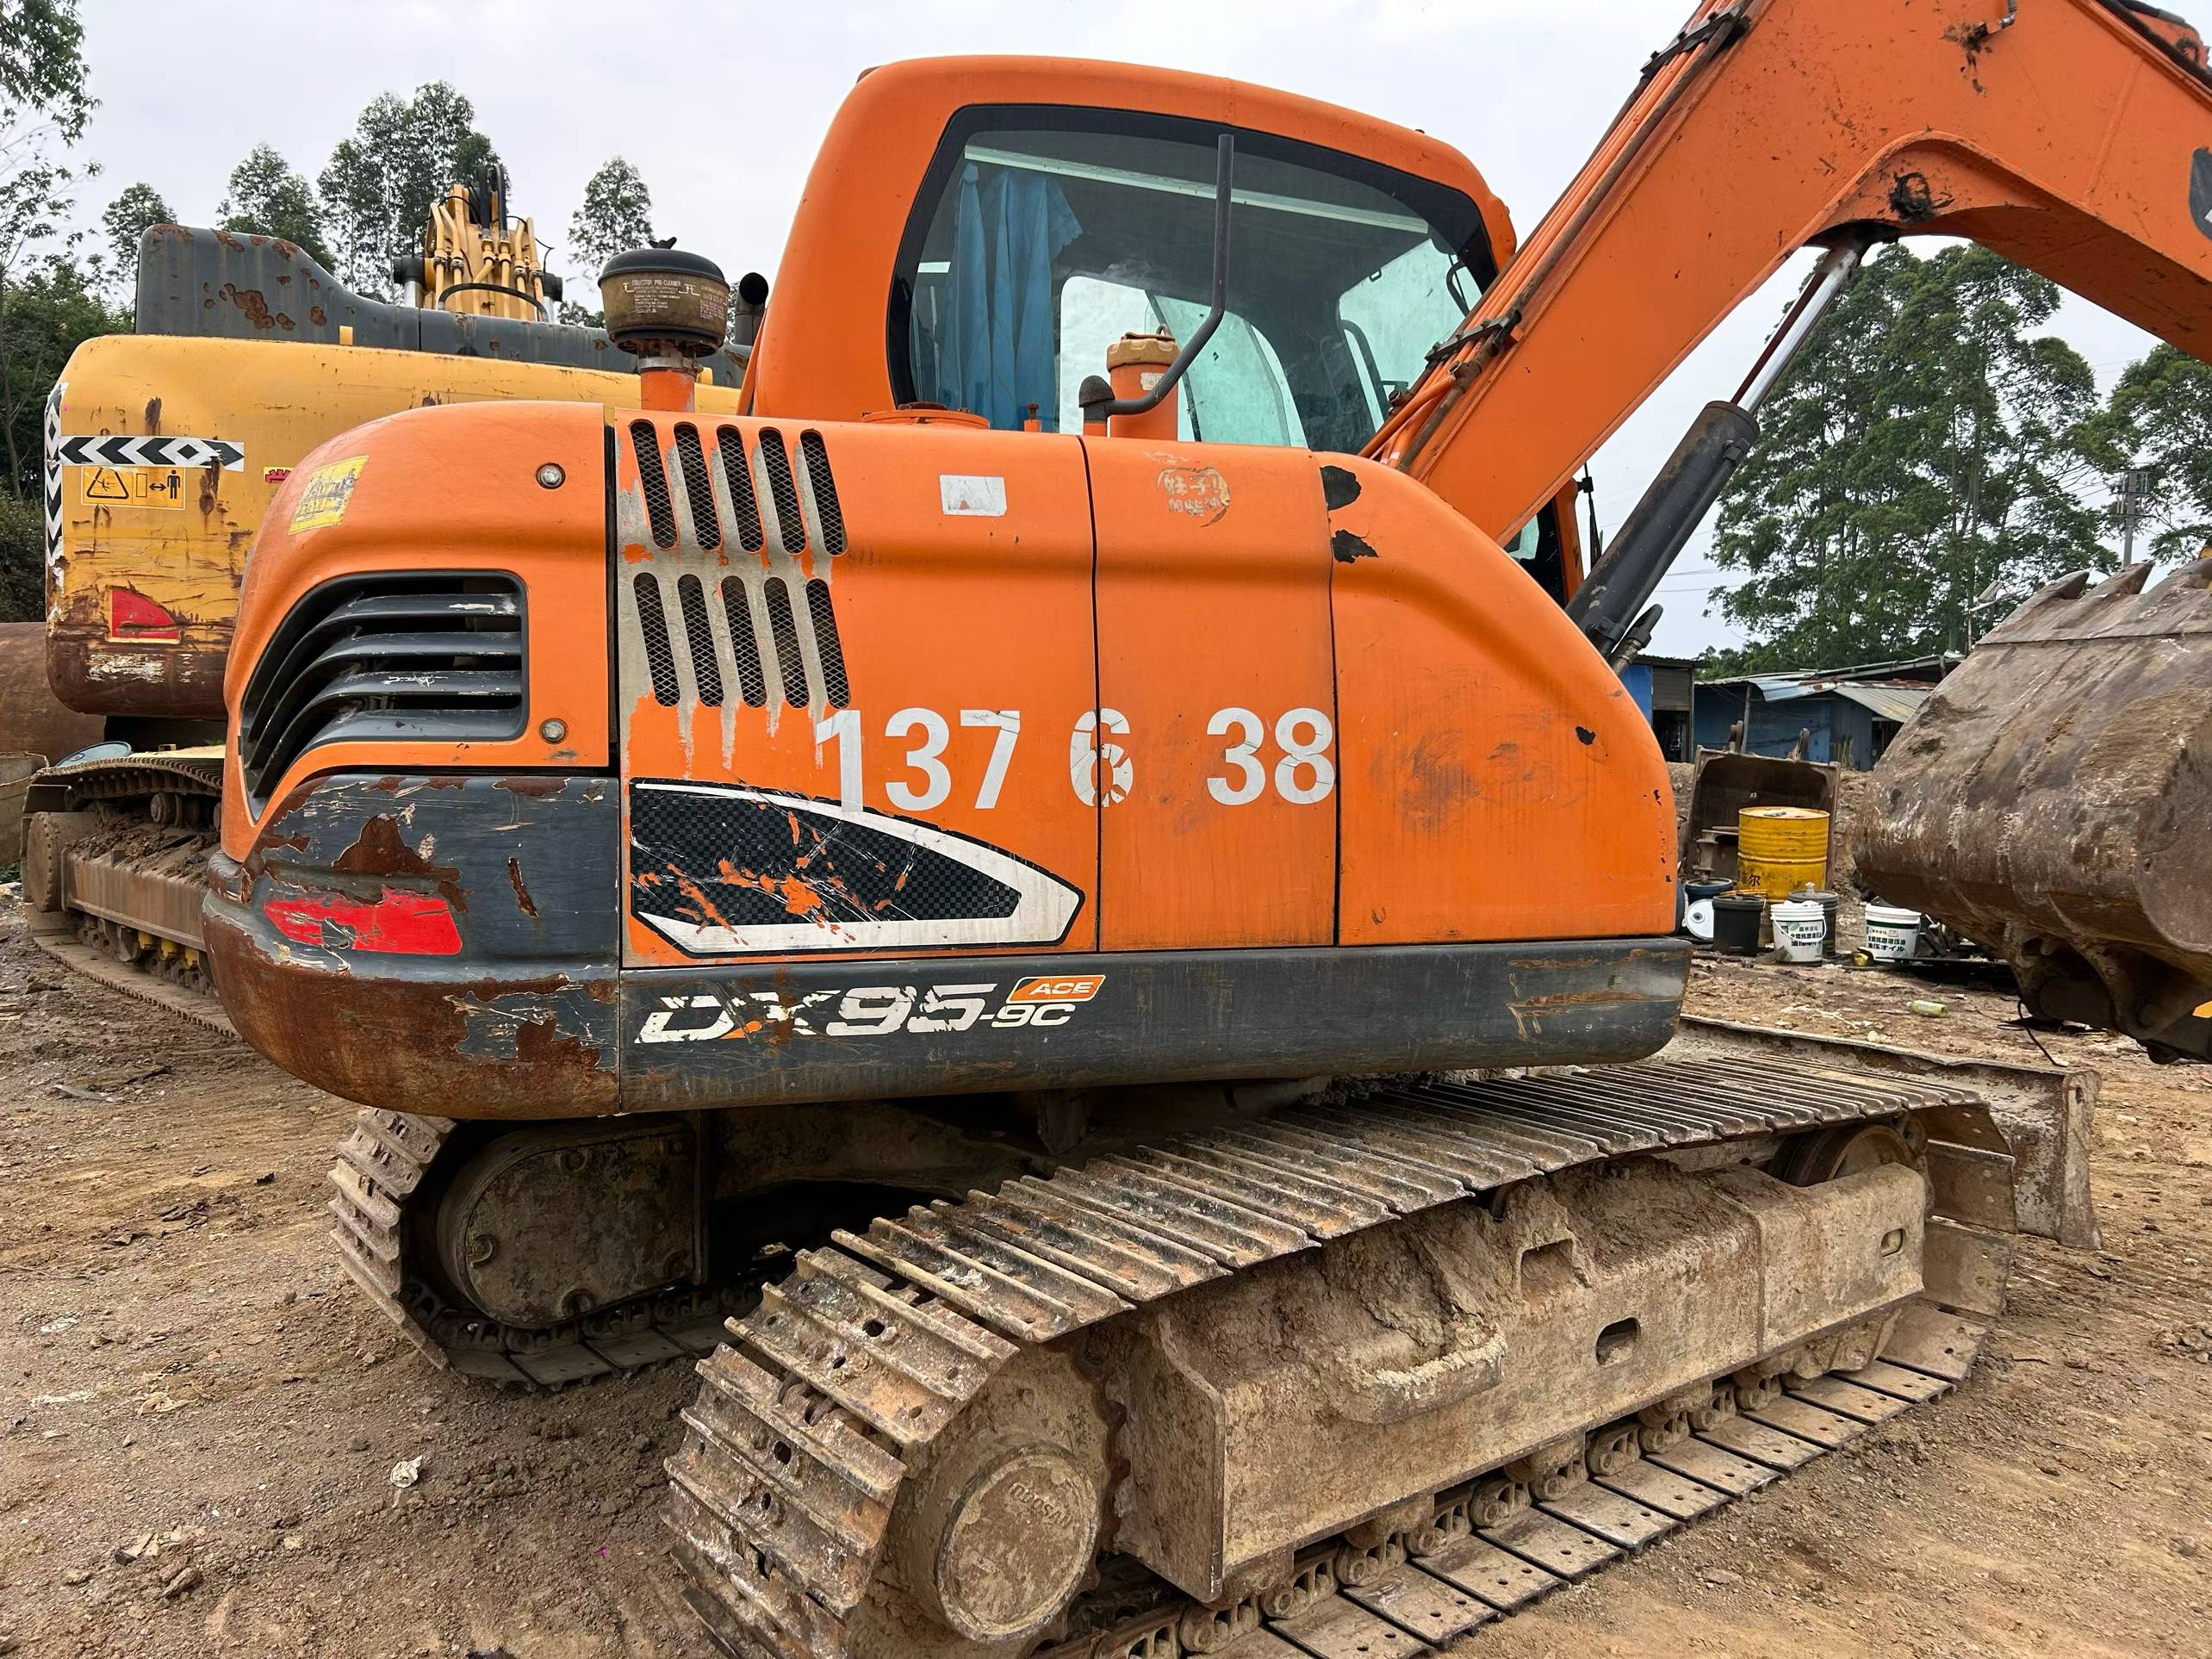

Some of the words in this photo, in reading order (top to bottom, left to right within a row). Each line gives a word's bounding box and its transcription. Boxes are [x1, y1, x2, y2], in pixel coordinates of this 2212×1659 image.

[816, 707, 1022, 812] 137
[1070, 708, 1134, 808] 6
[1207, 706, 1335, 806] 38
[1027, 979, 1094, 997] ACE
